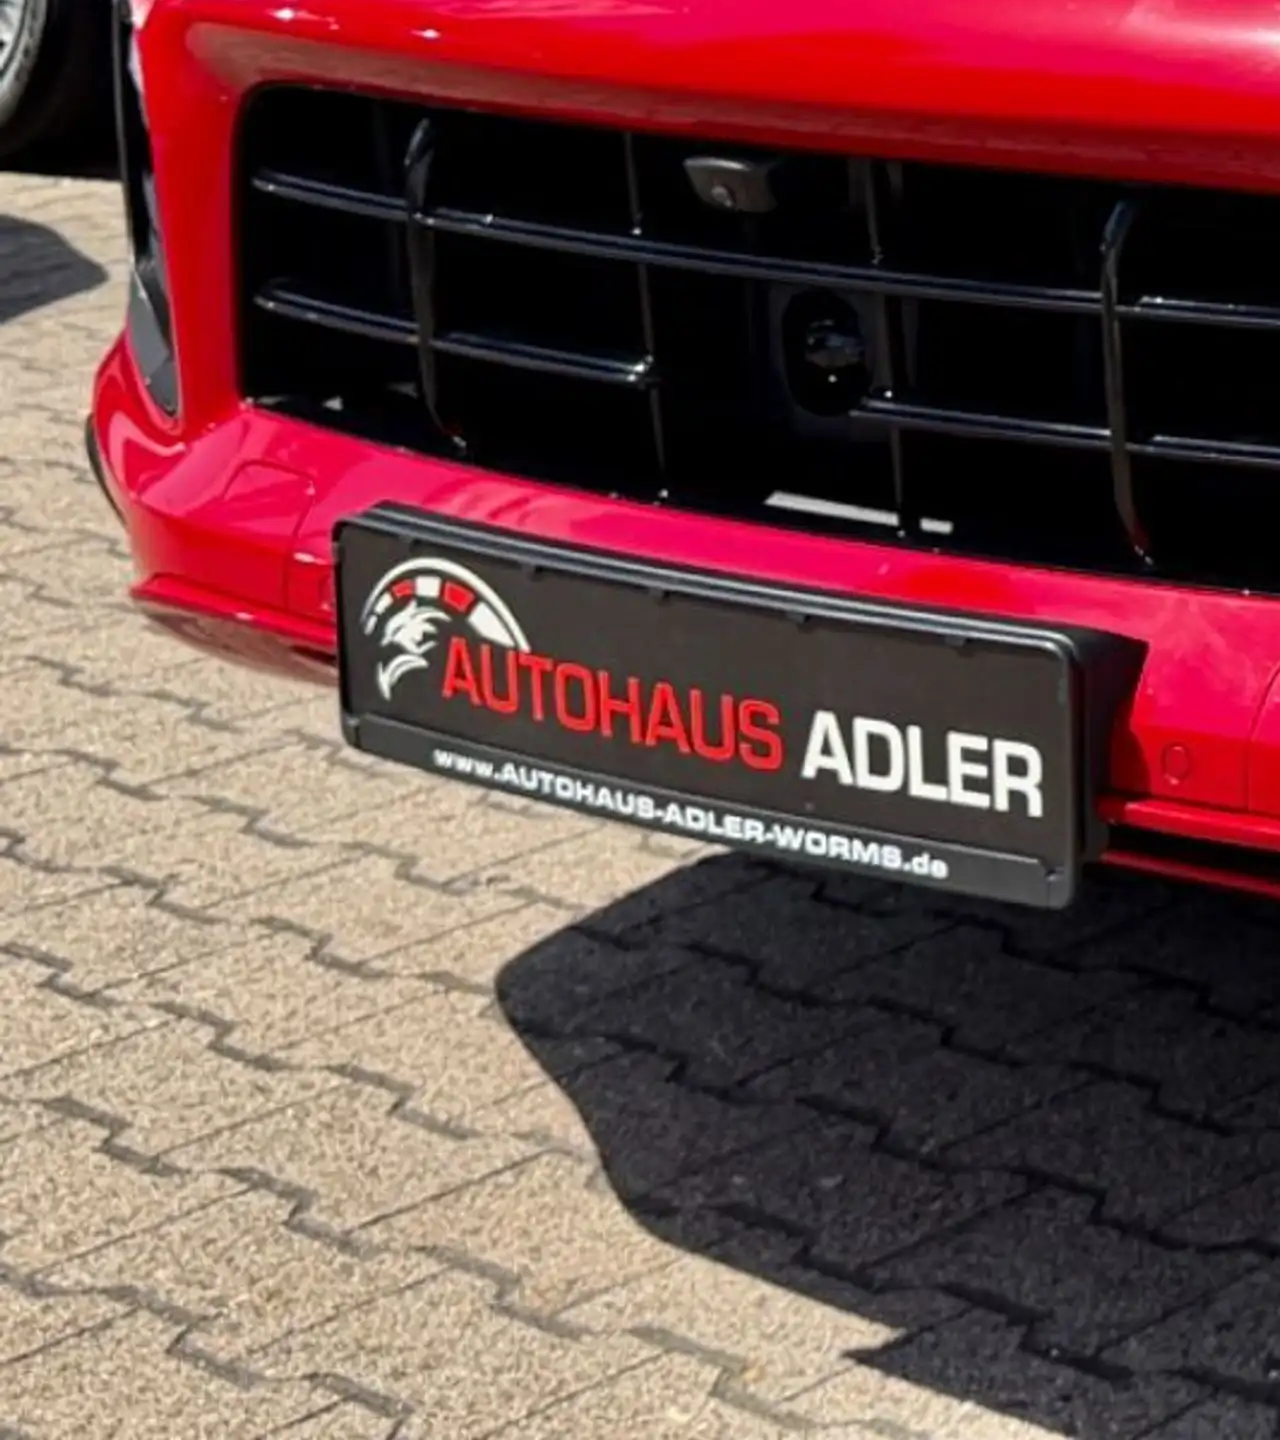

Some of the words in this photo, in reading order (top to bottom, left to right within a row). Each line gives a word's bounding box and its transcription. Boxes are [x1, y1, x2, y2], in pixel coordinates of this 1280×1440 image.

[442, 636, 784, 772] AUTOHAUS
[802, 710, 1044, 818] ADLER
[433, 747, 949, 880] www.AUTOHAUS-ADLER-WORMS.de
